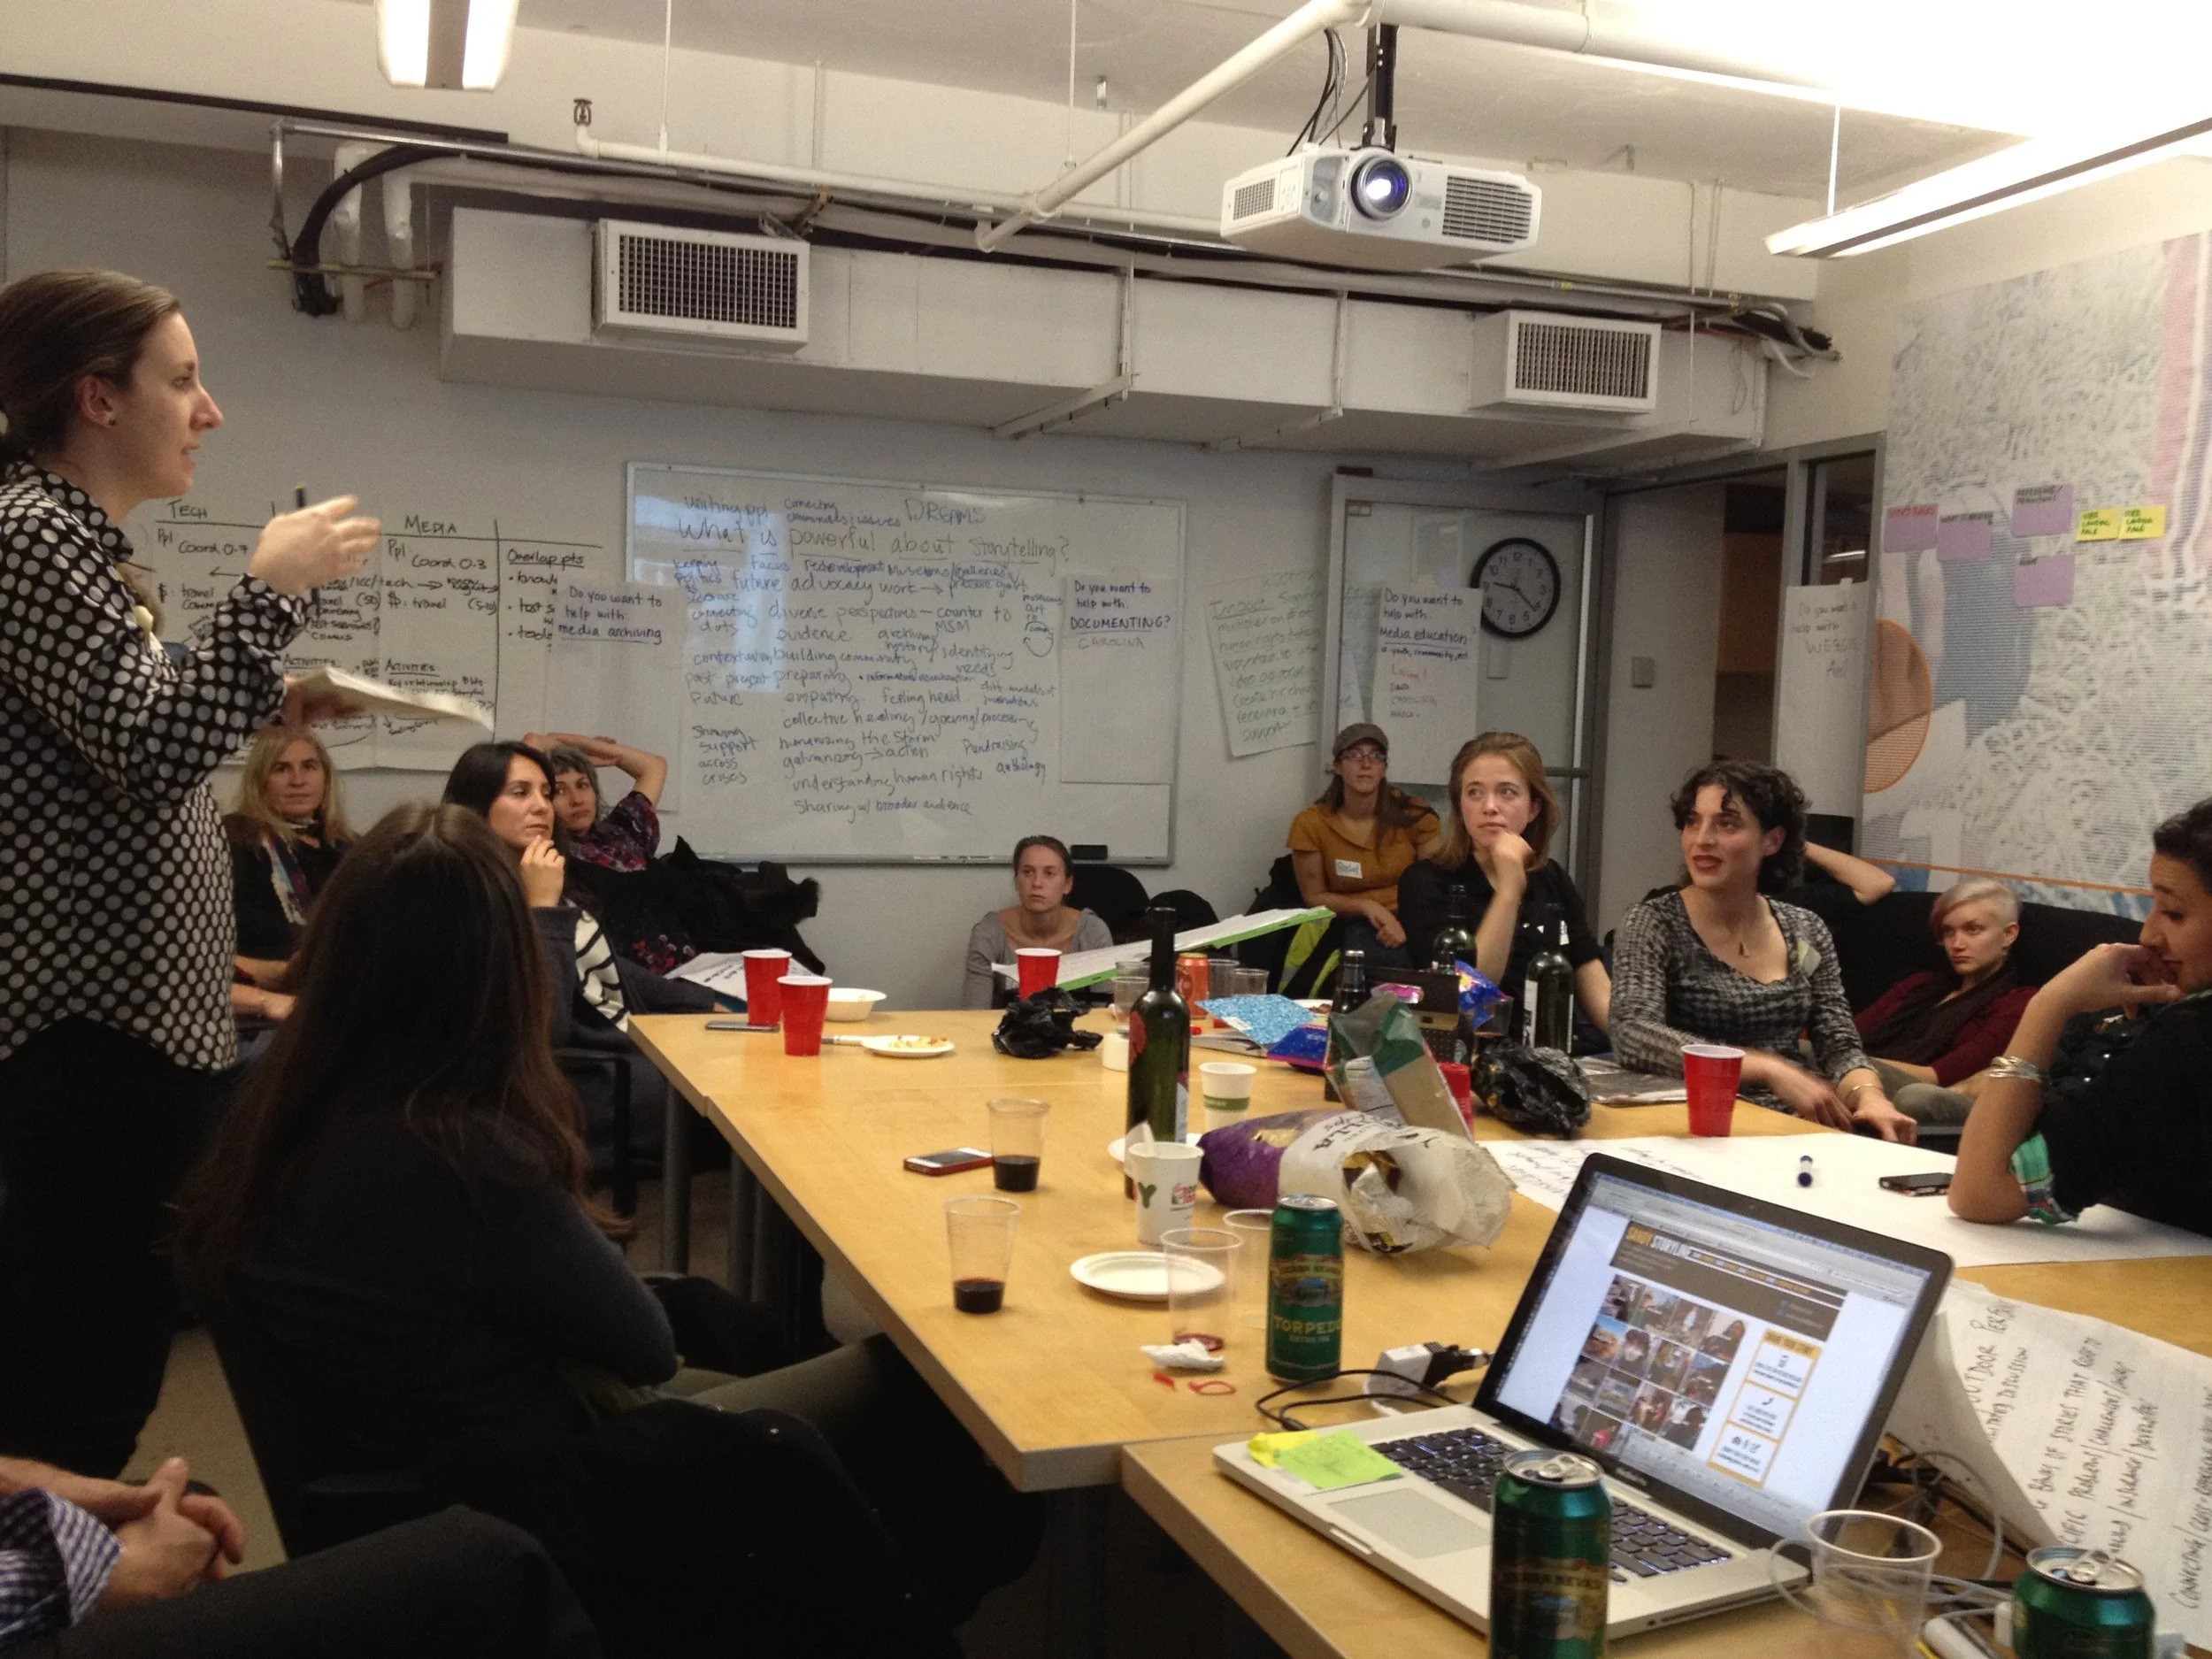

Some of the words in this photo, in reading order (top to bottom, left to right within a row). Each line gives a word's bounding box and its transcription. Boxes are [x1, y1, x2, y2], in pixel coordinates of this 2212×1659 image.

[166, 498, 208, 518] TECH
[904, 498, 987, 526] DREAMS
[404, 513, 457, 534] MEDIA
[680, 517, 745, 543] What
[760, 529, 777, 546] is
[790, 526, 875, 559] powerful
[892, 533, 955, 555] about
[792, 572, 872, 606] advocacy
[880, 581, 918, 594] work
[1074, 580, 1086, 592] Do
[1089, 585, 1105, 595] you
[1110, 581, 1136, 594] want
[1141, 581, 1152, 594] to
[570, 586, 584, 598] Do
[588, 591, 606, 603] you
[611, 592, 643, 605] want
[647, 594, 663, 608] to
[1077, 598, 1097, 610] help
[1385, 588, 1399, 603] Do
[1402, 593, 1420, 606] you
[1423, 594, 1448, 605] want
[1452, 595, 1463, 606] to
[565, 605, 590, 619] help
[769, 600, 828, 618] diverse
[995, 606, 1012, 623] to
[1384, 608, 1402, 619] help
[935, 620, 971, 634] MSM
[1070, 614, 1171, 630] DOCUMENTING?
[557, 624, 600, 636] media
[608, 625, 663, 645] archiving
[1414, 627, 1468, 645] education
[773, 647, 839, 673] building
[783, 711, 849, 729] collective
[699, 736, 759, 757] support
[863, 730, 890, 746] the
[886, 745, 930, 759] action
[698, 757, 739, 770] across
[702, 770, 749, 786] crises
[793, 772, 895, 797] understanding
[894, 767, 937, 785] human
[2062, 1372, 2092, 1399] THAT
